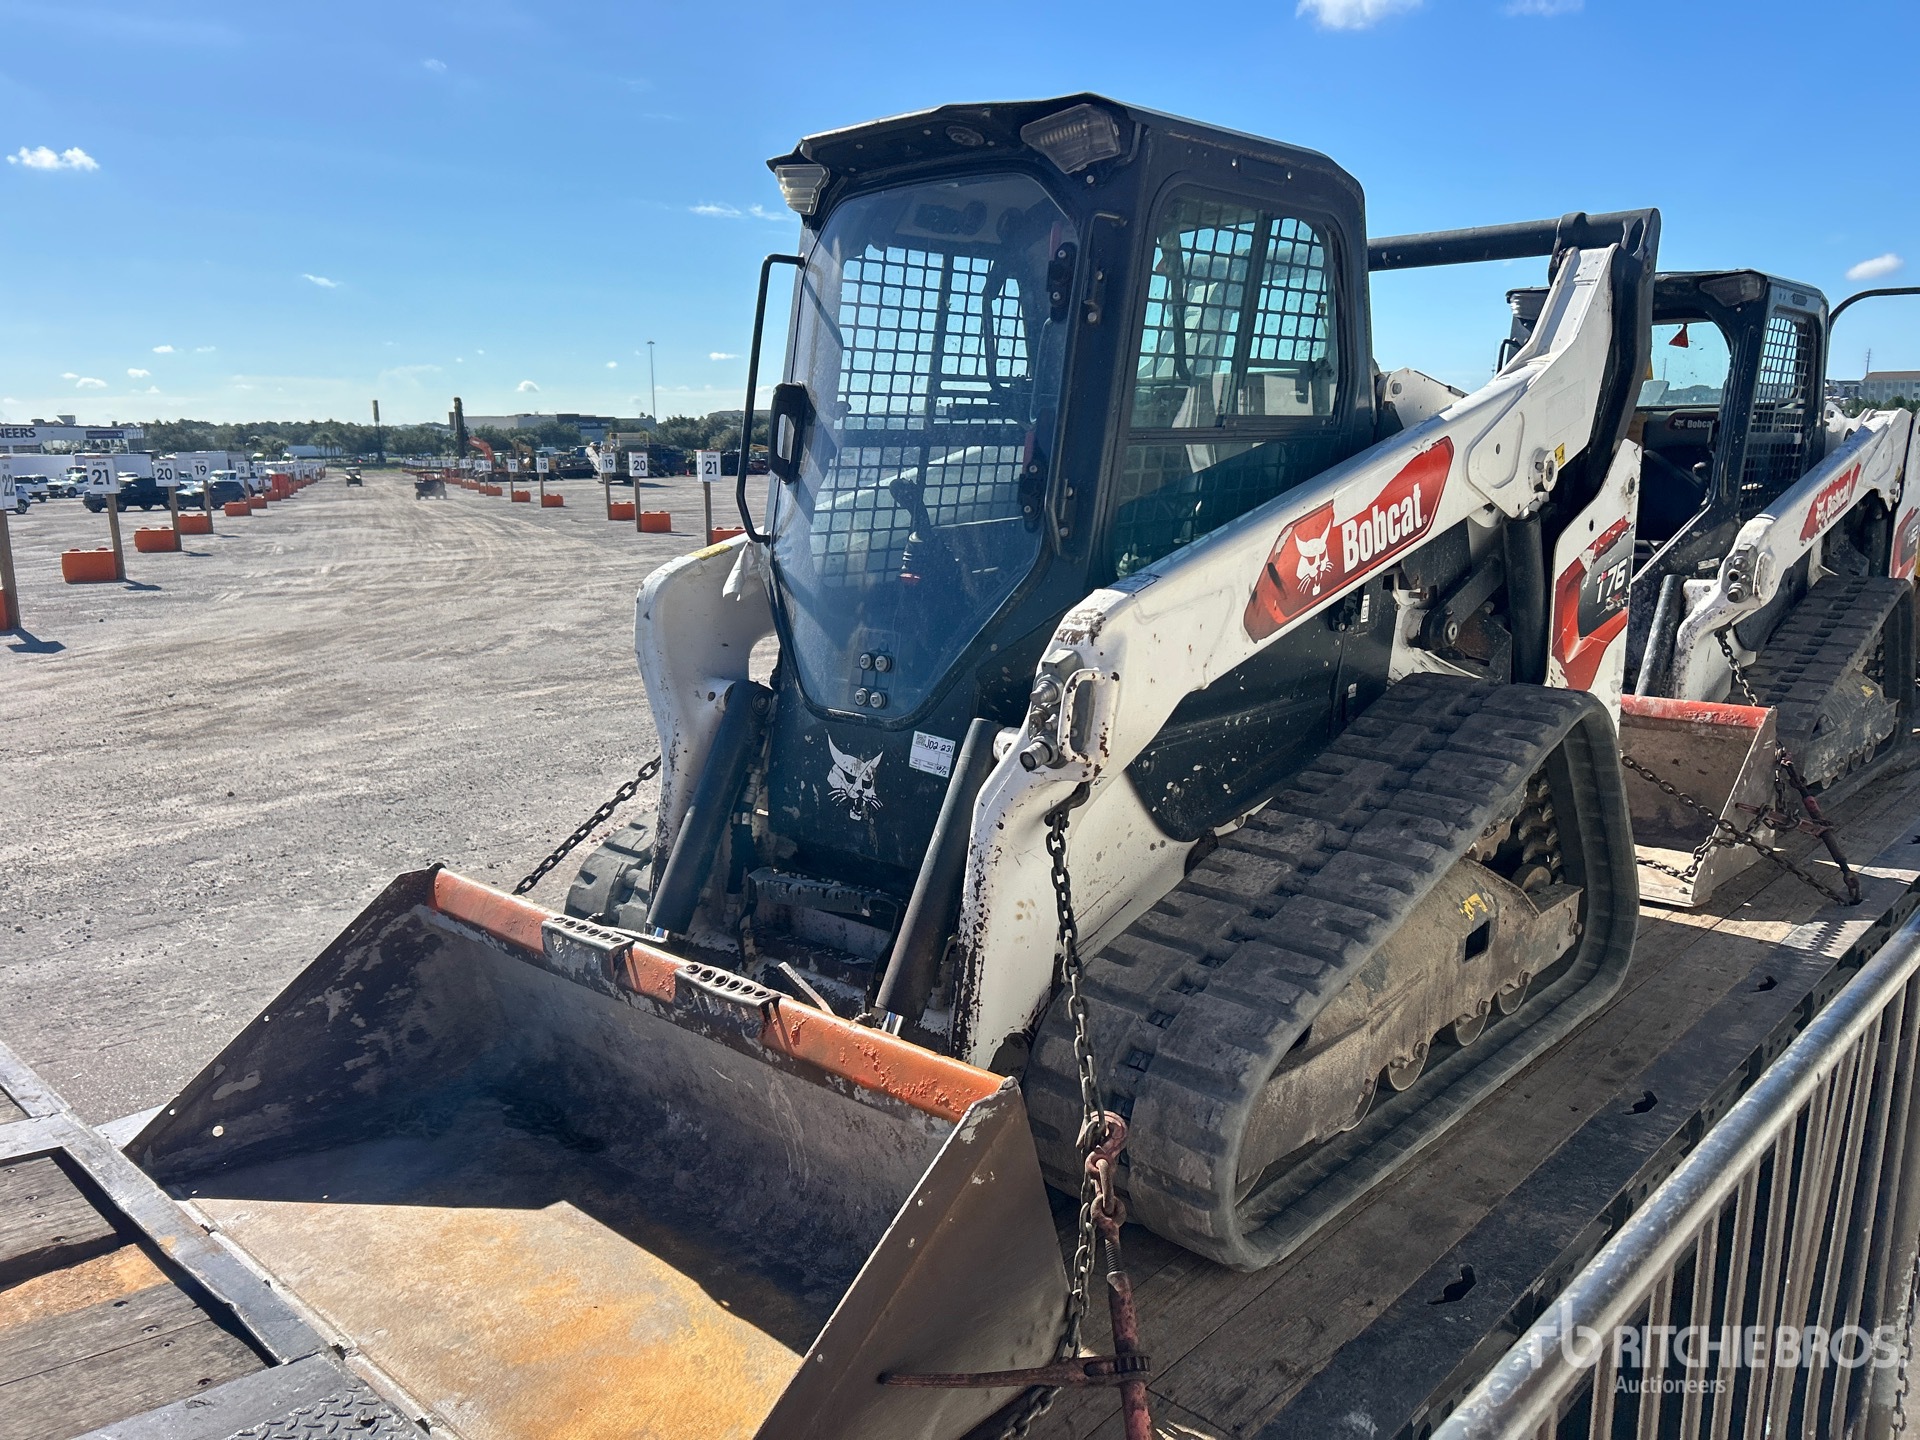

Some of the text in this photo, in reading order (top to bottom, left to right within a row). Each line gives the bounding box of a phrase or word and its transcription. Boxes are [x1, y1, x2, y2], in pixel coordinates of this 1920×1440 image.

[1687, 419, 1714, 429] Bobca
[539, 462, 547, 470] 18
[604, 459, 614, 468] 19
[633, 461, 646, 471] 20
[705, 461, 717, 475] 21
[156, 468, 173, 480] 20
[194, 465, 207, 475] 19
[91, 469, 111, 486] 21
[2, 473, 15, 497] 22
[1341, 482, 1423, 574] Bobcat
